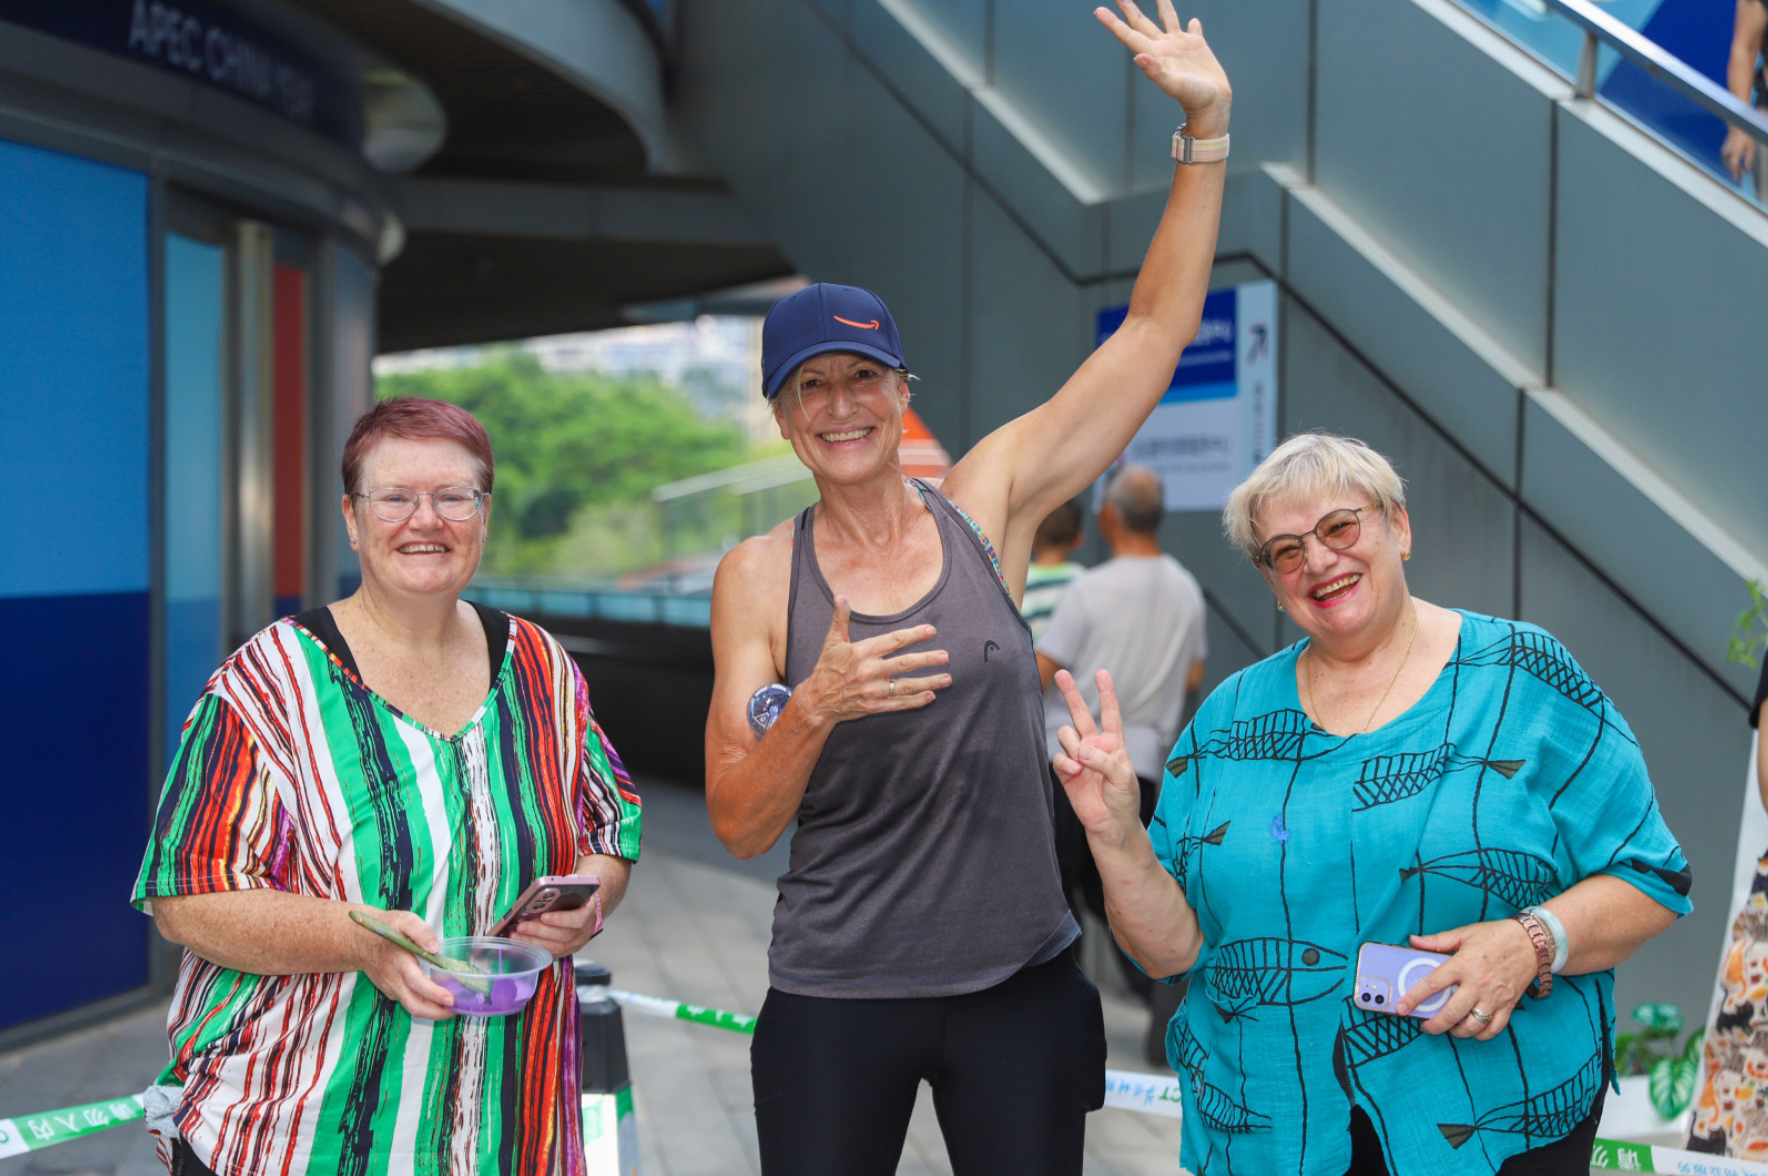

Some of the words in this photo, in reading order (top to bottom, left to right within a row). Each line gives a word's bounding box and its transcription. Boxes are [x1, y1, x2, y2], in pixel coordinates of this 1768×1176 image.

[129, 0, 203, 72] APEC
[27, 1102, 136, 1140] 请勿入内
